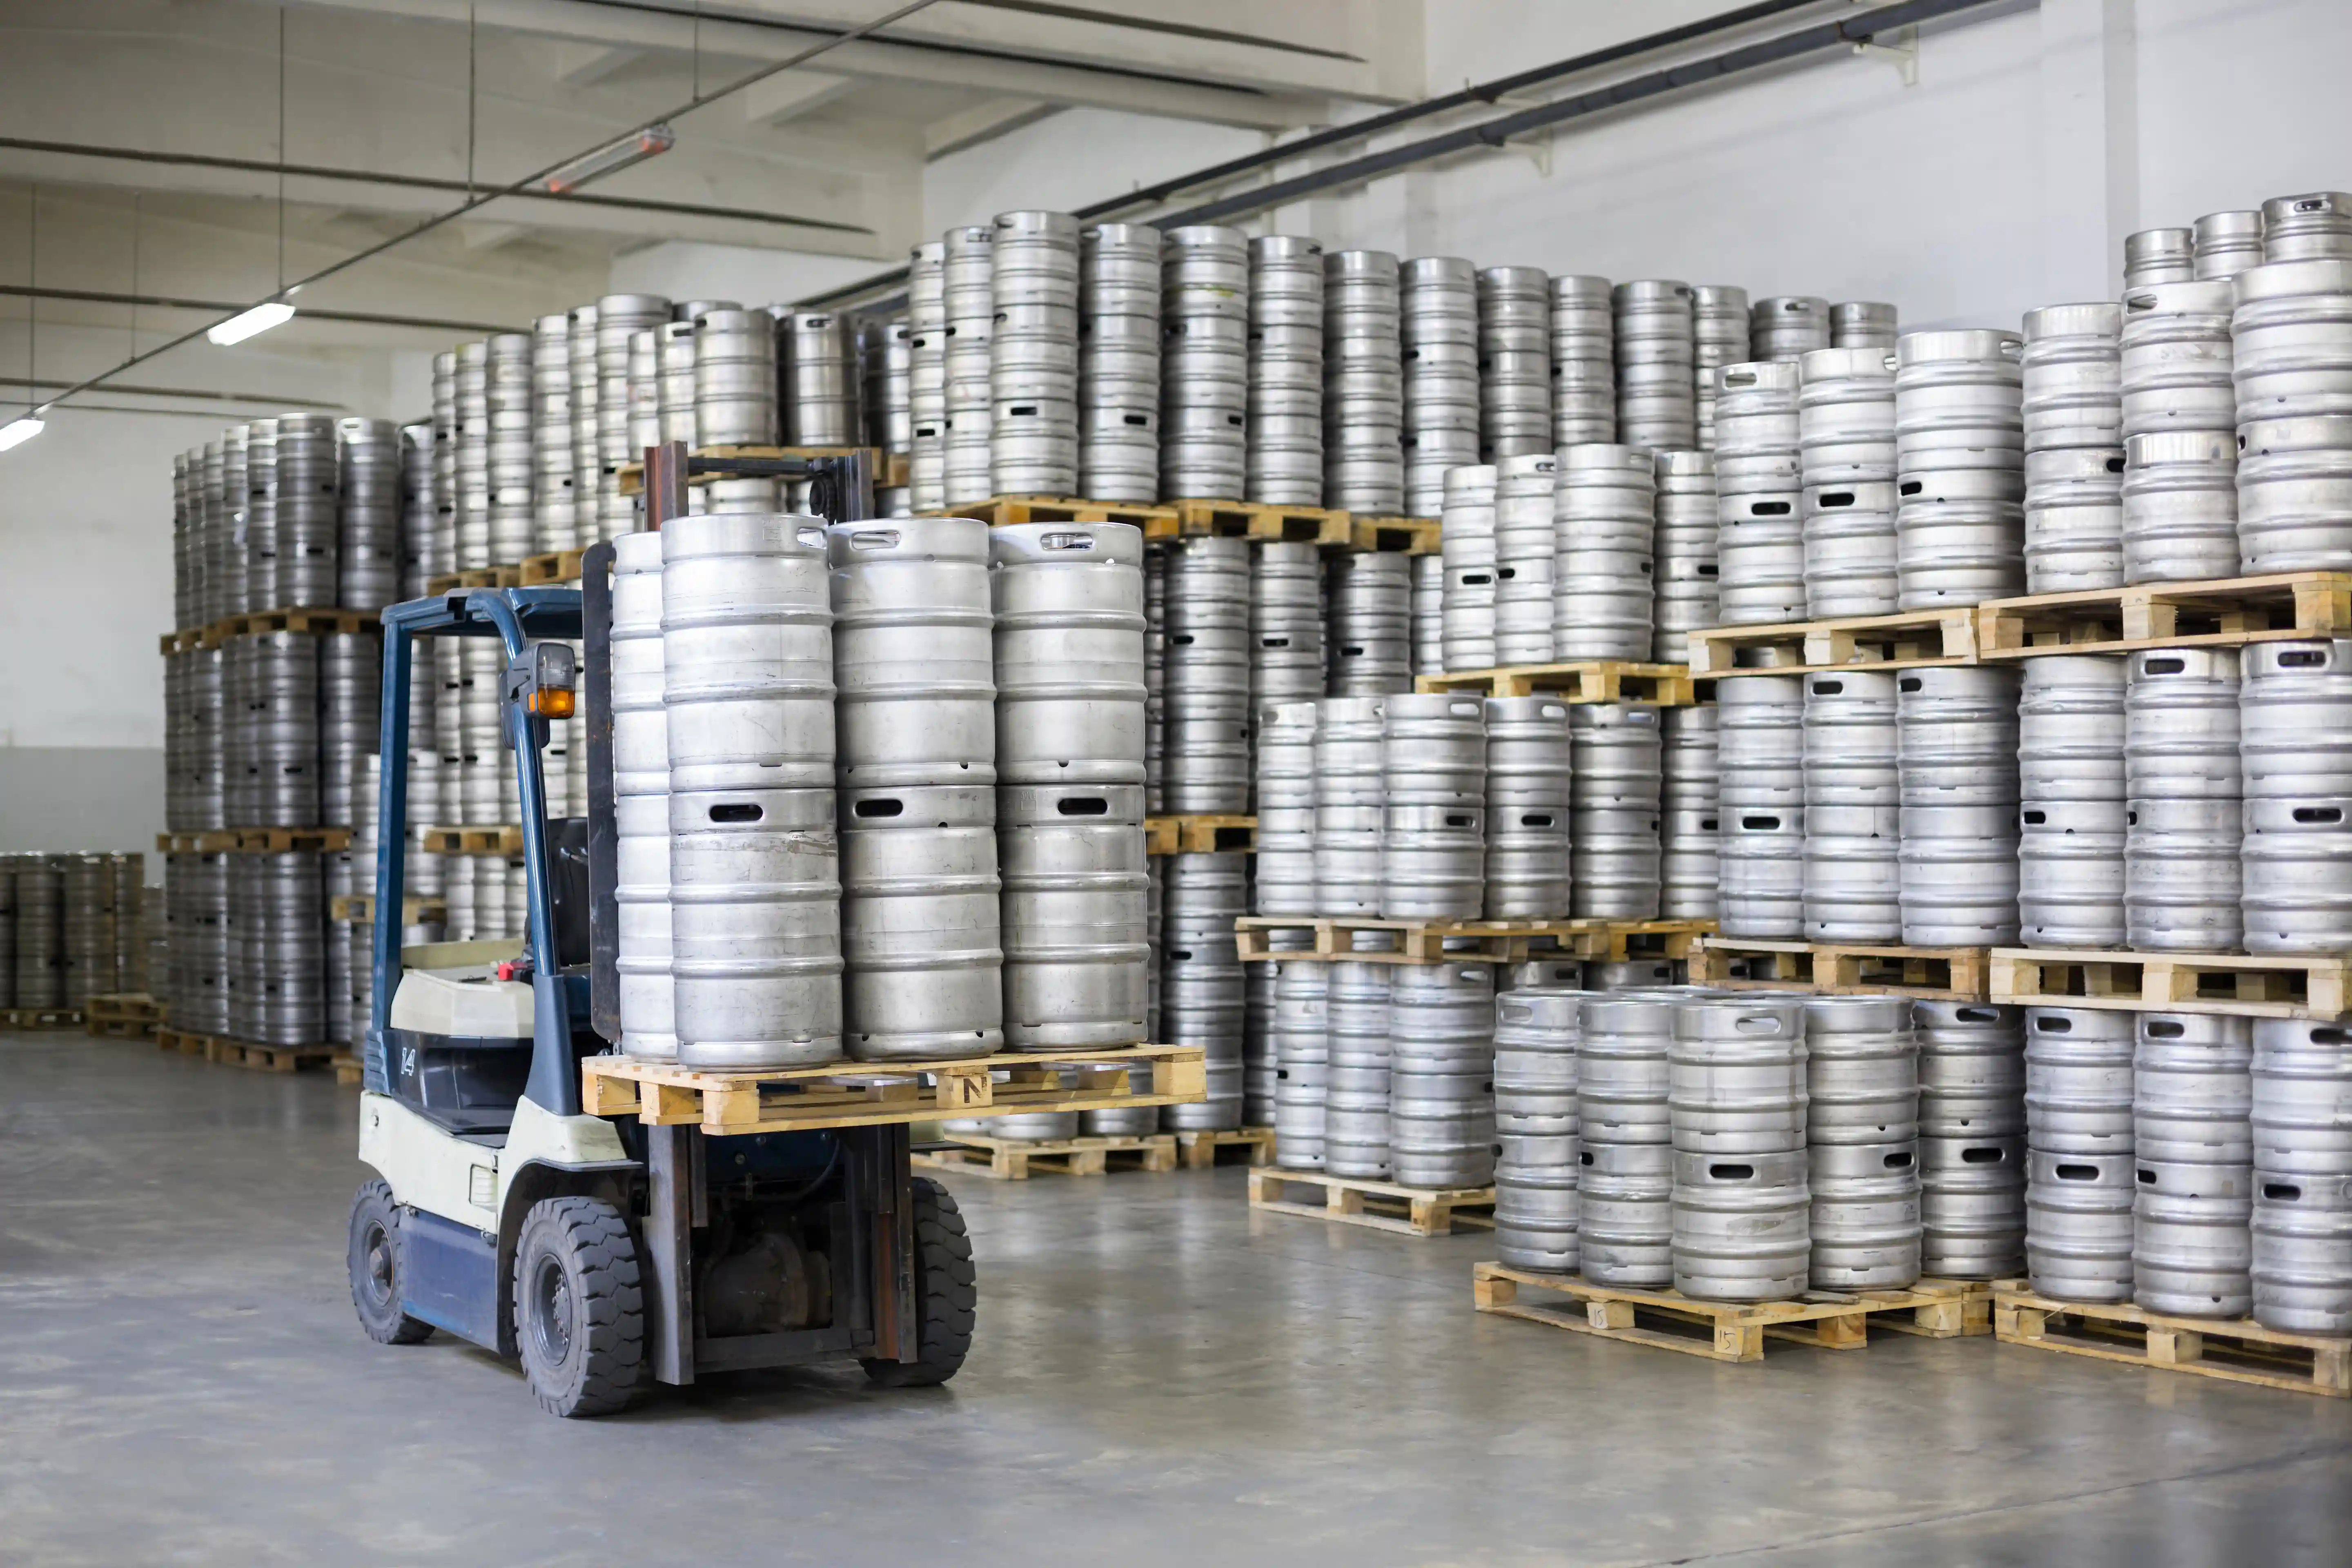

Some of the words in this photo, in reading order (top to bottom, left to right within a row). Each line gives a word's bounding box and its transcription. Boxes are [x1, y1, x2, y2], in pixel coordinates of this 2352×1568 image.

[401, 1047, 416, 1076] 14
[963, 1077, 987, 1103] N
[1594, 1309, 1604, 1327] 15
[1720, 1330, 1735, 1350] 15
